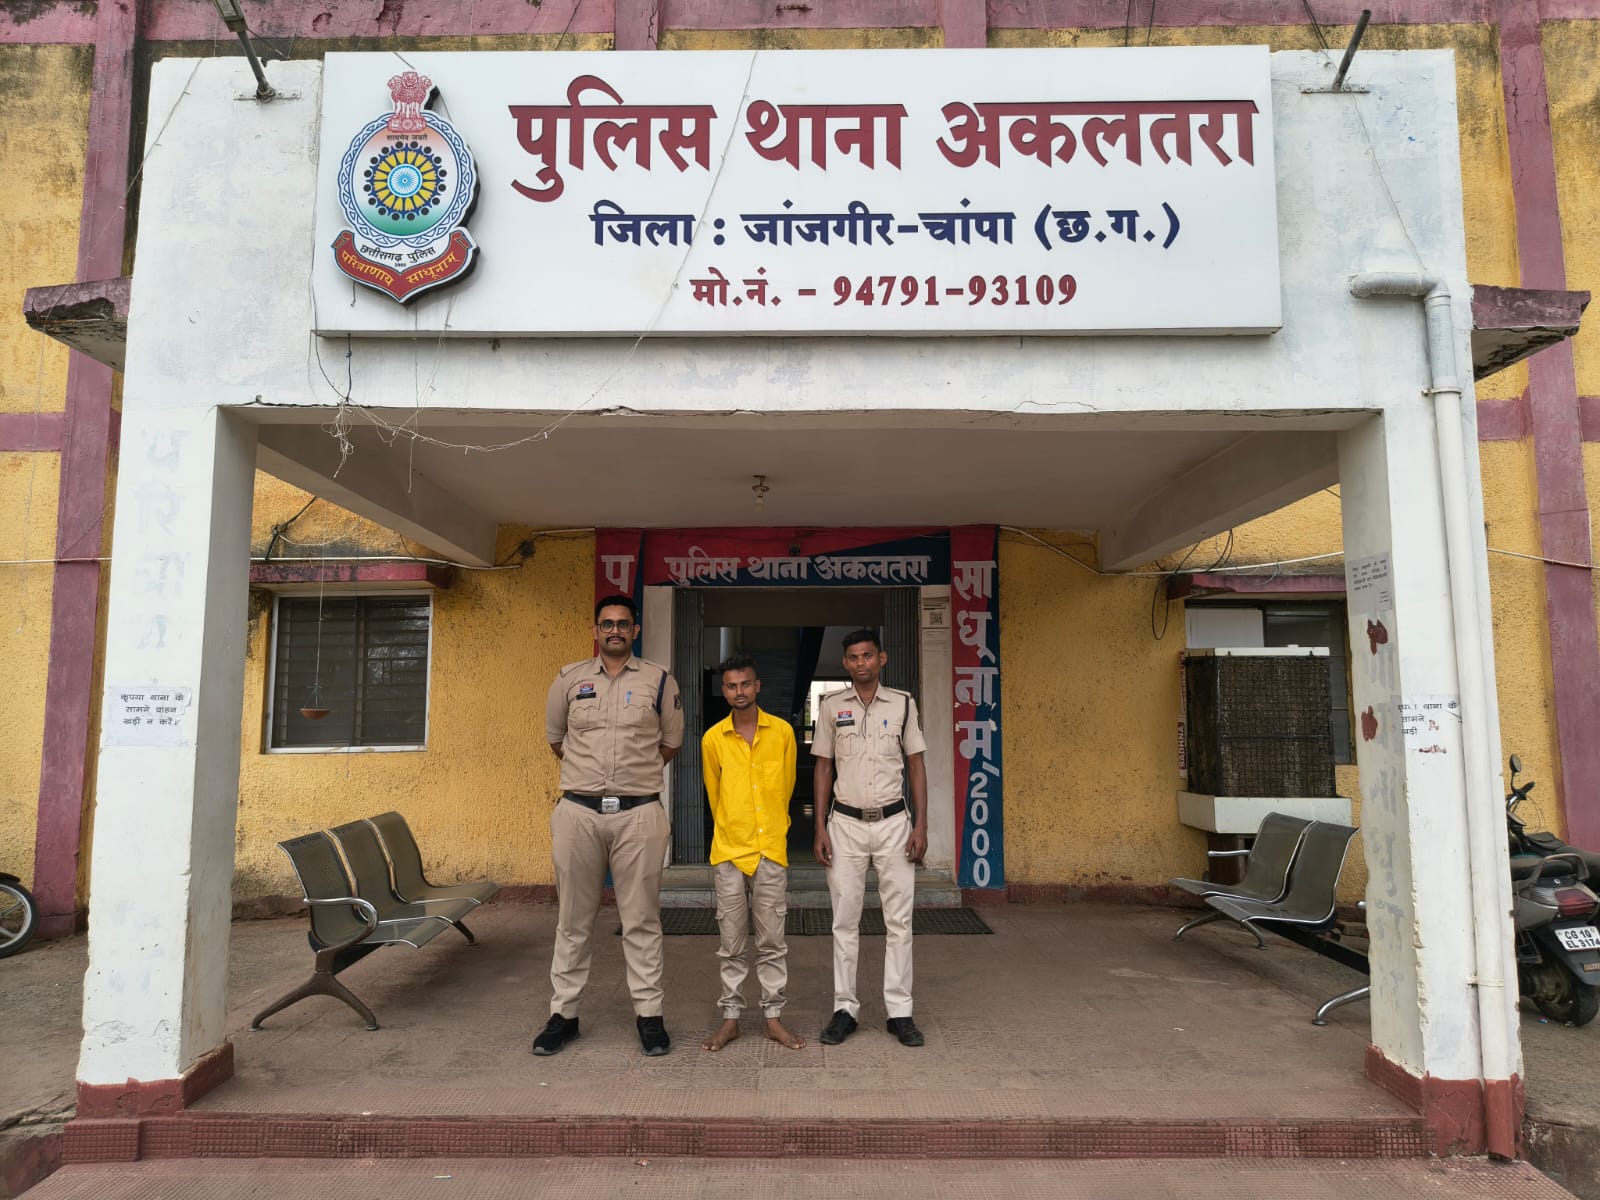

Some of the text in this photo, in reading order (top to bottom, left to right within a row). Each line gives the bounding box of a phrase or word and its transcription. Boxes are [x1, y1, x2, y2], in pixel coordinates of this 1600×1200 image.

[508, 74, 1259, 203] पुलिस थाना अकलतरा
[589, 199, 696, 246] जिला
[740, 197, 1016, 246] जांजगीर-चांपा
[1033, 201, 1181, 251] (छ.ग.)
[407, 246, 436, 263] पुलिस
[689, 266, 782, 307] मो.नं.
[833, 273, 1077, 307] 94791-93109
[664, 546, 931, 587] पुलिस थाना अकलतरा
[1564, 930, 1578, 940] CG
[1566, 940, 1580, 949] EL
